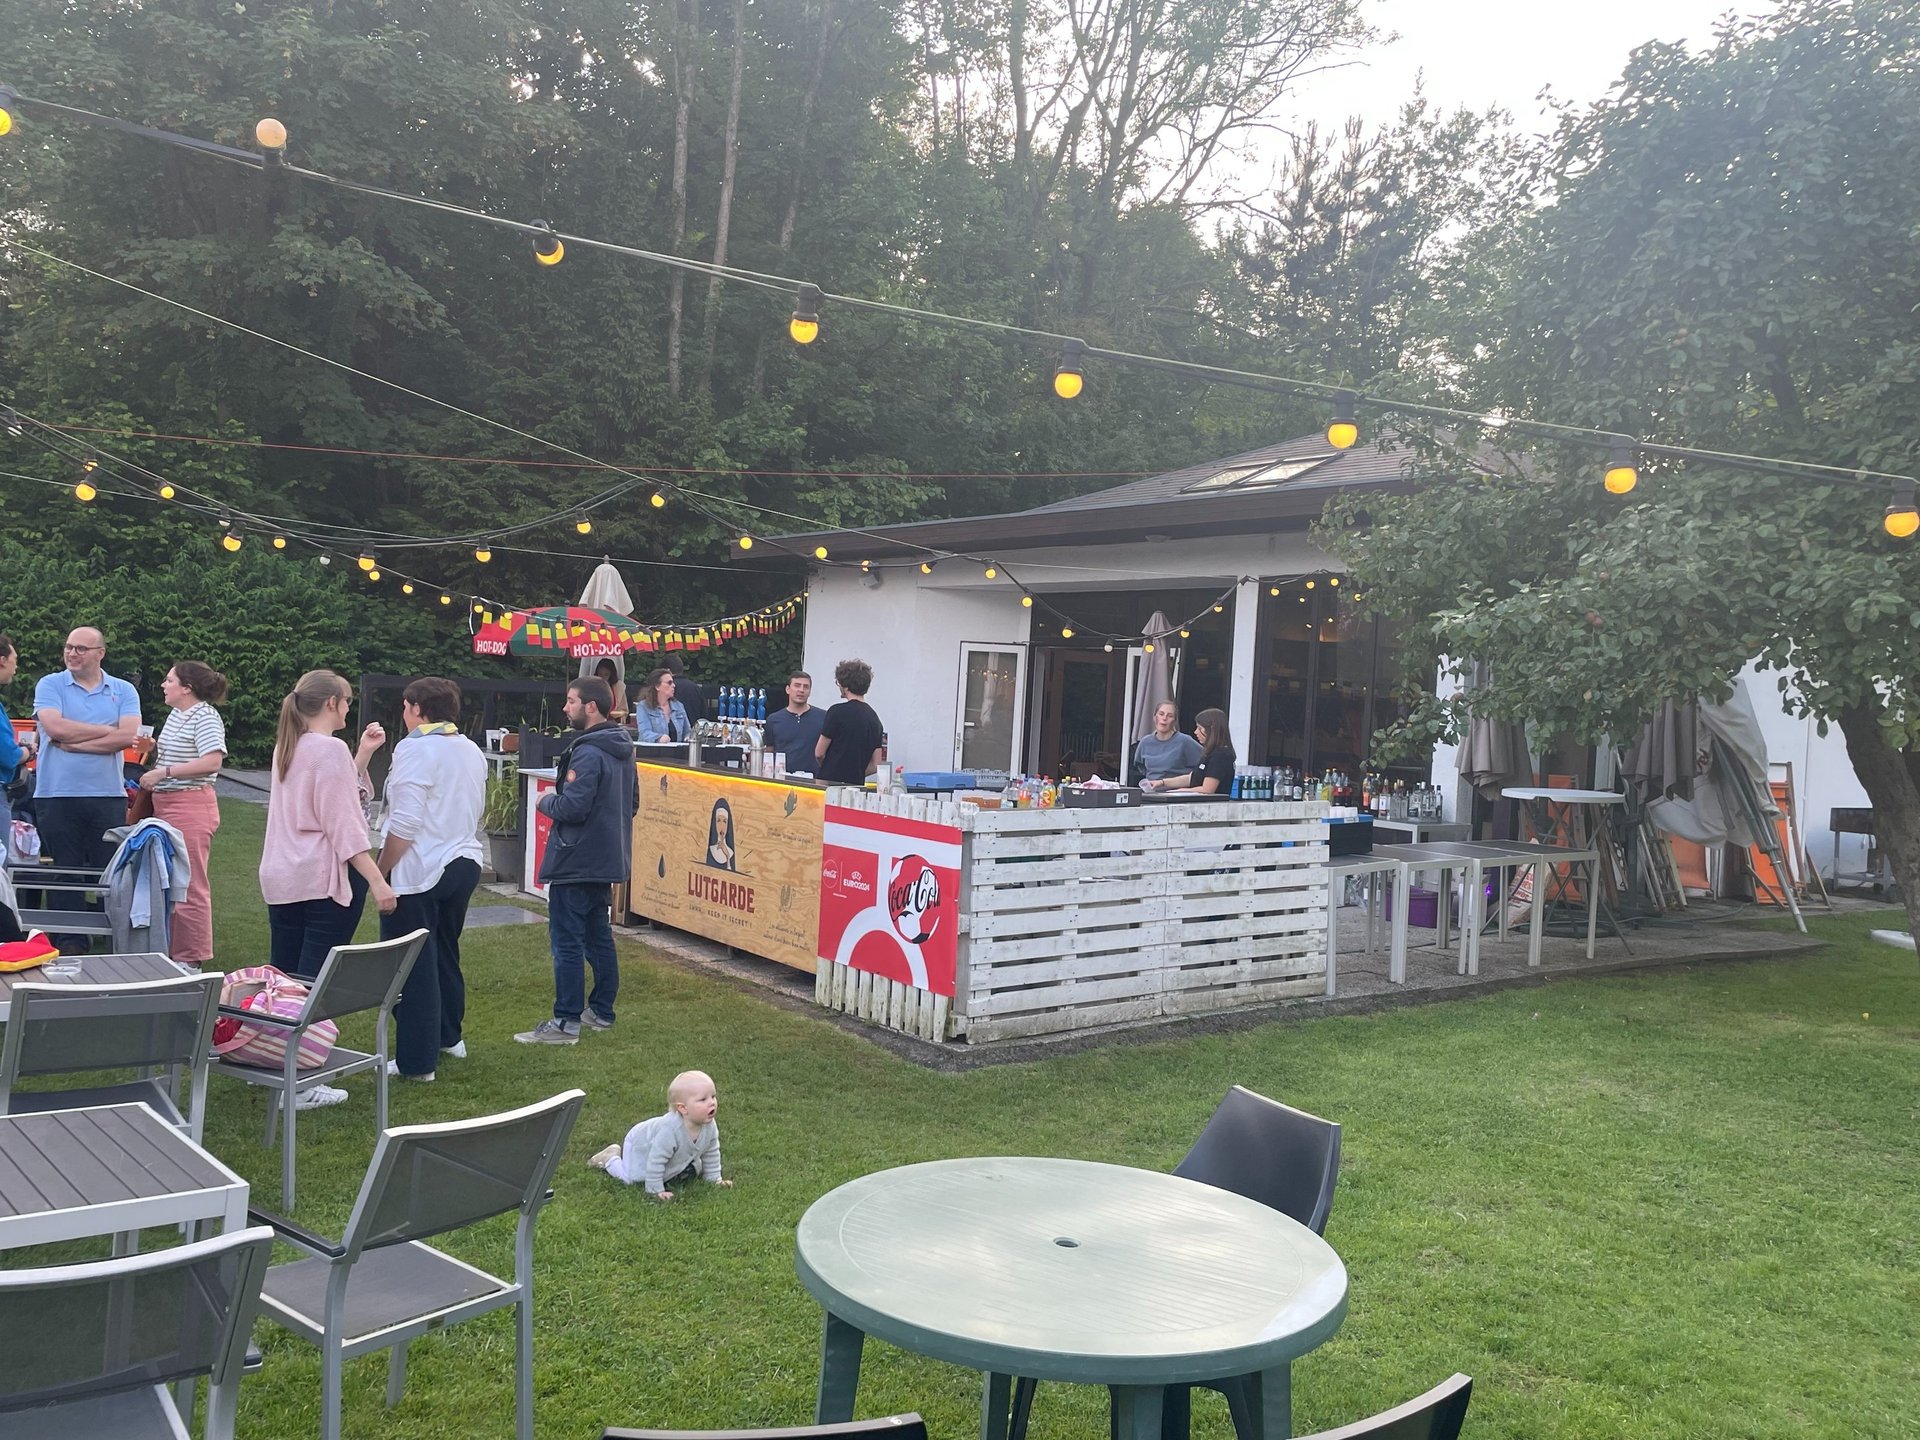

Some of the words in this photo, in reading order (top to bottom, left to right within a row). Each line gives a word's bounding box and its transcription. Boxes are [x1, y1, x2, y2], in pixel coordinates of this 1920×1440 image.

[476, 640, 507, 655] HOT-DOG
[573, 643, 621, 657] HOT-DOG
[688, 872, 755, 913] LUTGARDE
[729, 915, 748, 927] SECRET
